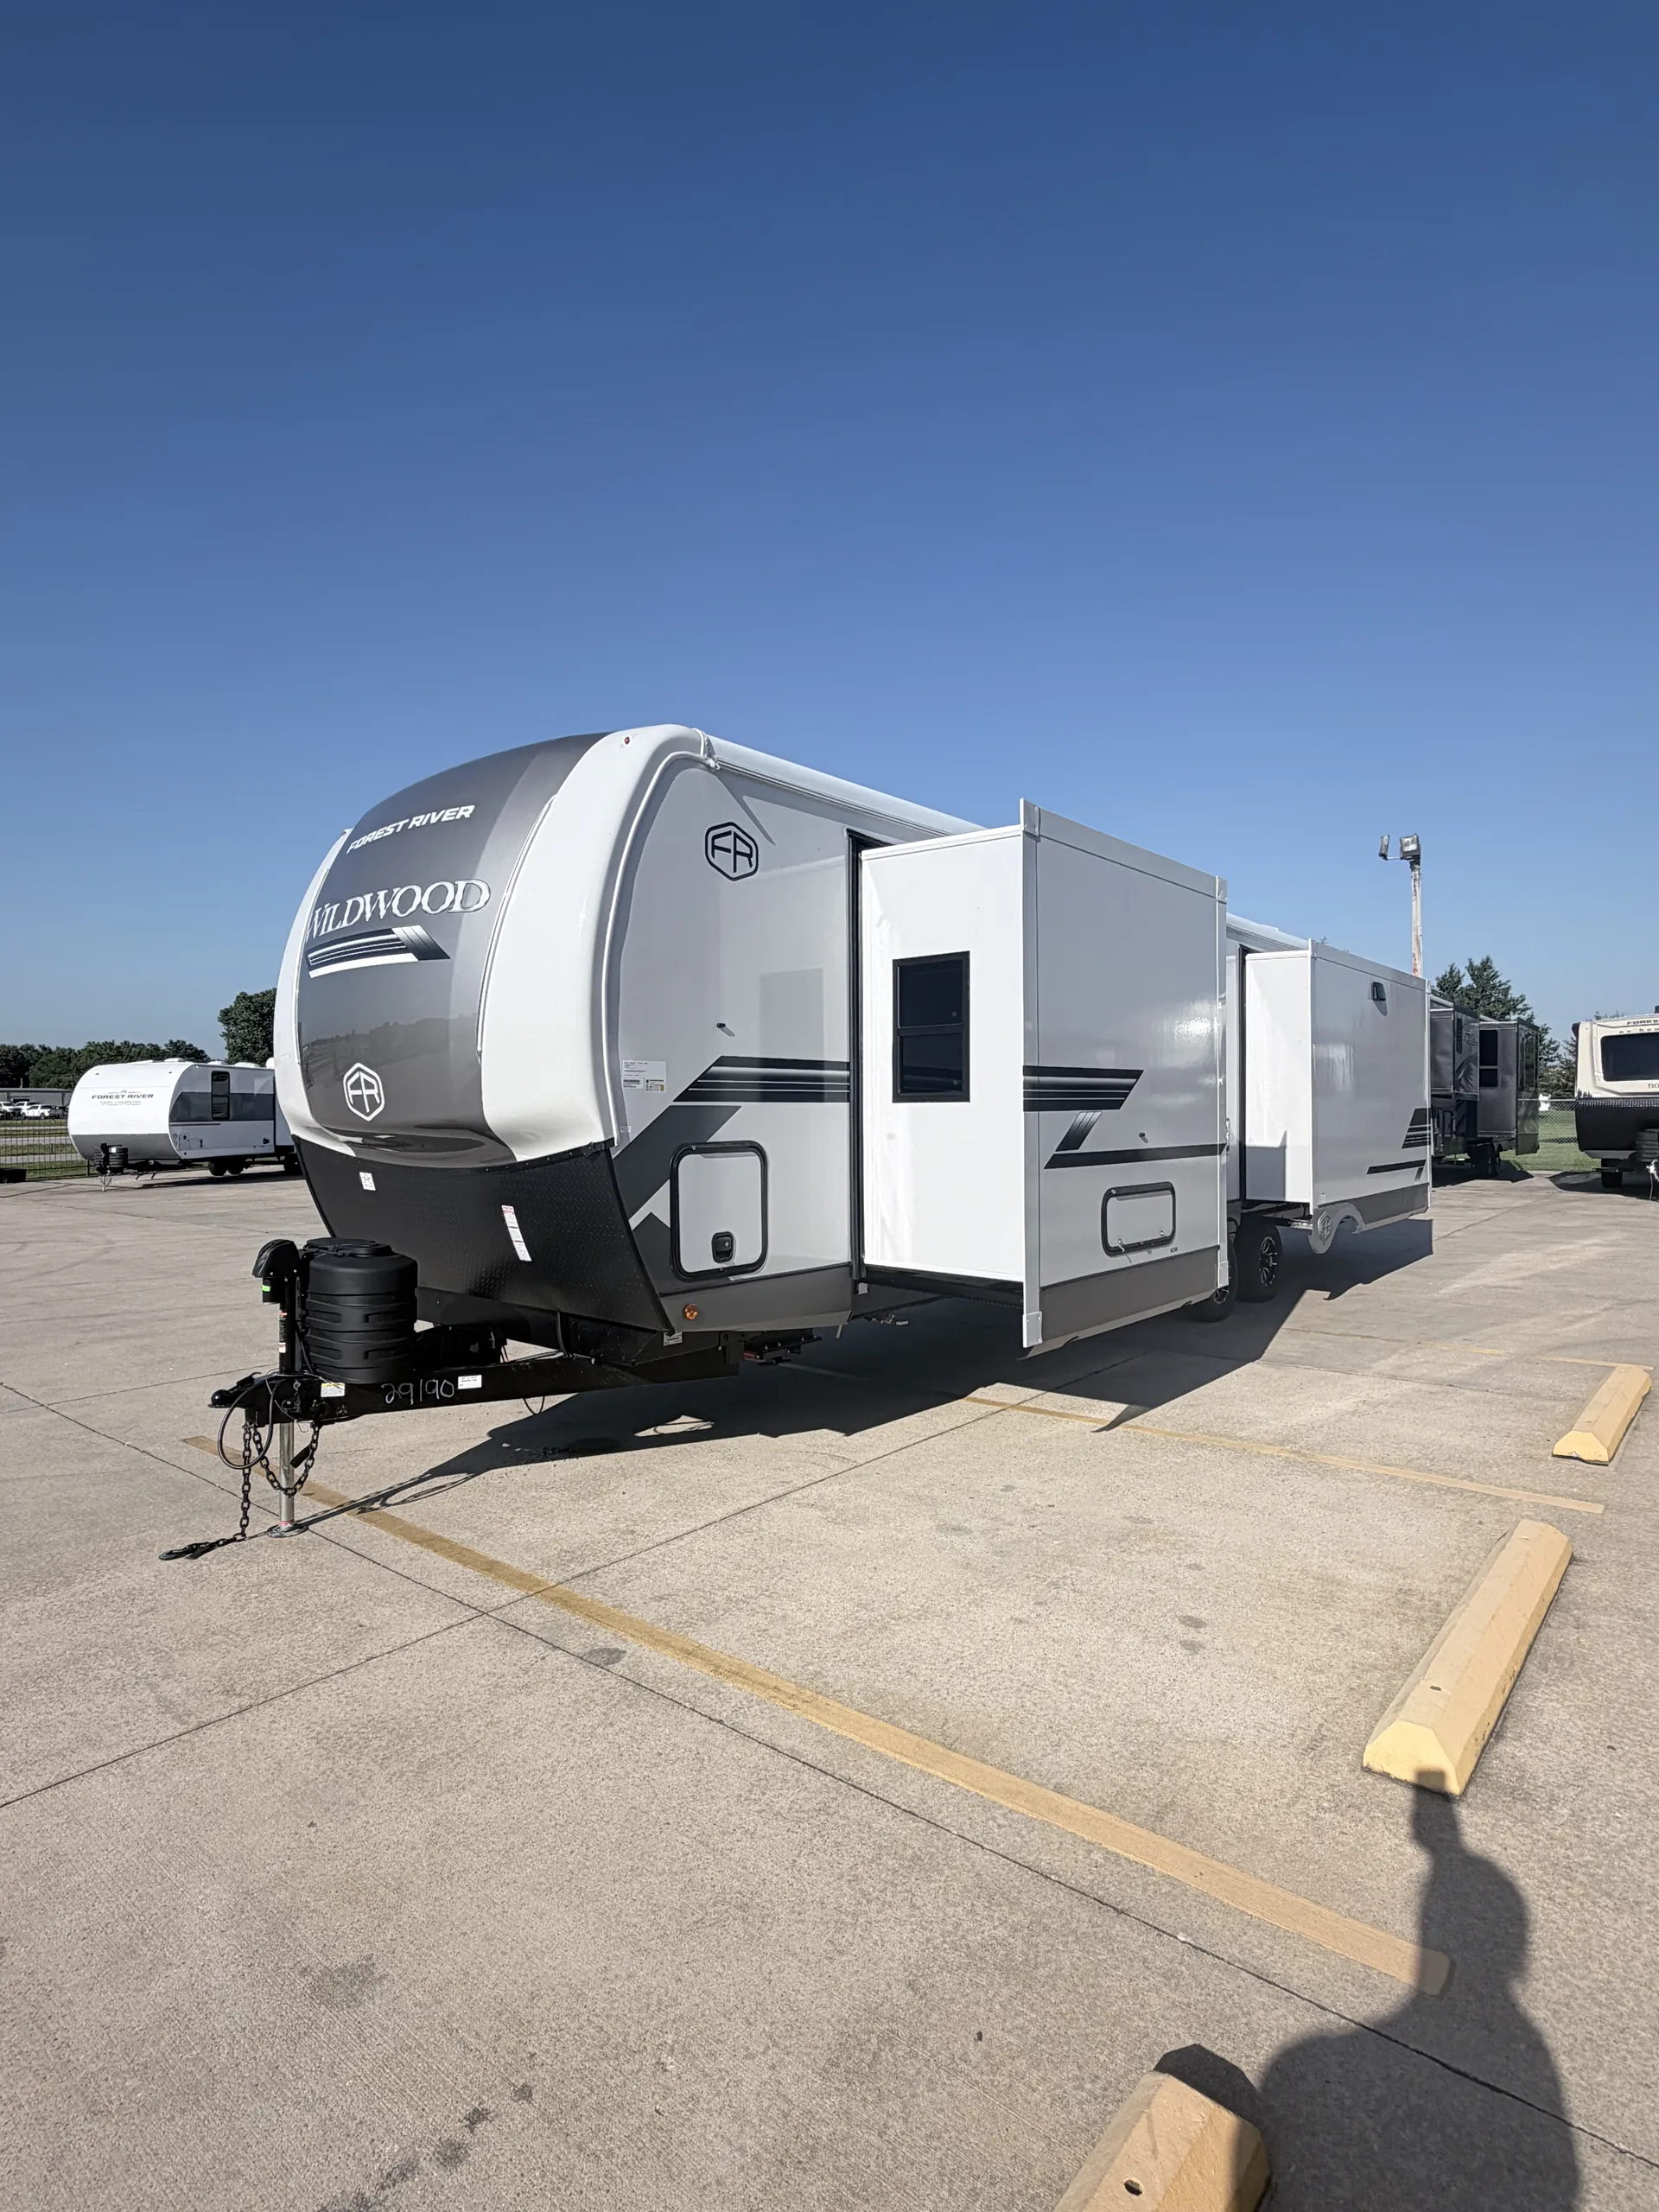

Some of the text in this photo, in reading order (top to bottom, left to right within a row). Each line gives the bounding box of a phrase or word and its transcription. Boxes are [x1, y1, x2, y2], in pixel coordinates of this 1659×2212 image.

[346, 804, 475, 854] FOREST RIVER
[306, 879, 491, 943] WILDWOOD
[381, 1378, 455, 1405] 29190
